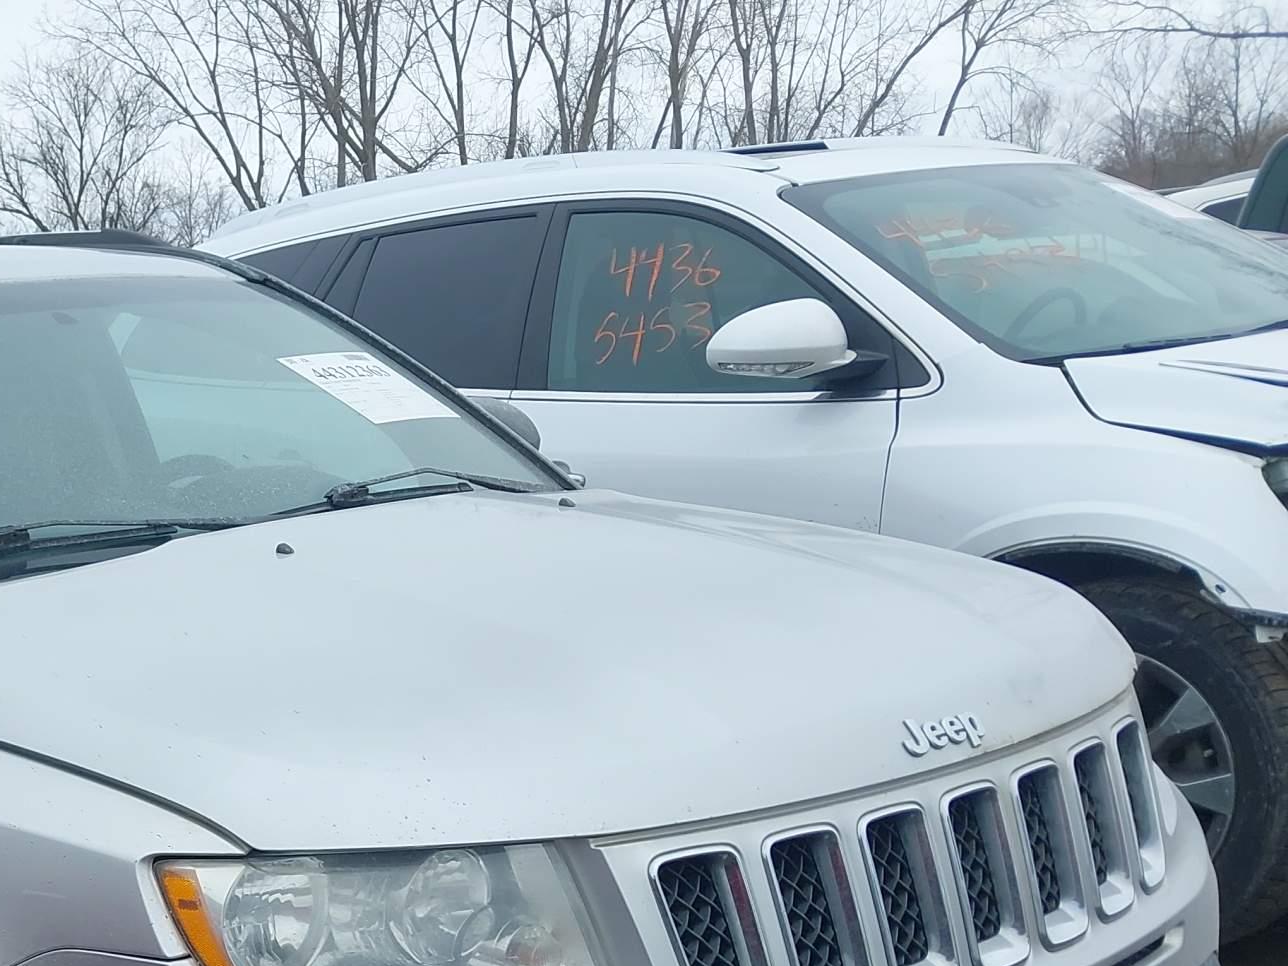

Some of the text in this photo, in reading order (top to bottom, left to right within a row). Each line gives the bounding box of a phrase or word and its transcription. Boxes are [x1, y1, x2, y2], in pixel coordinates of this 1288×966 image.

[609, 242, 721, 303] 4436
[594, 301, 712, 367] 5453
[311, 364, 392, 380] 44312363
[901, 712, 985, 758] Jeep
